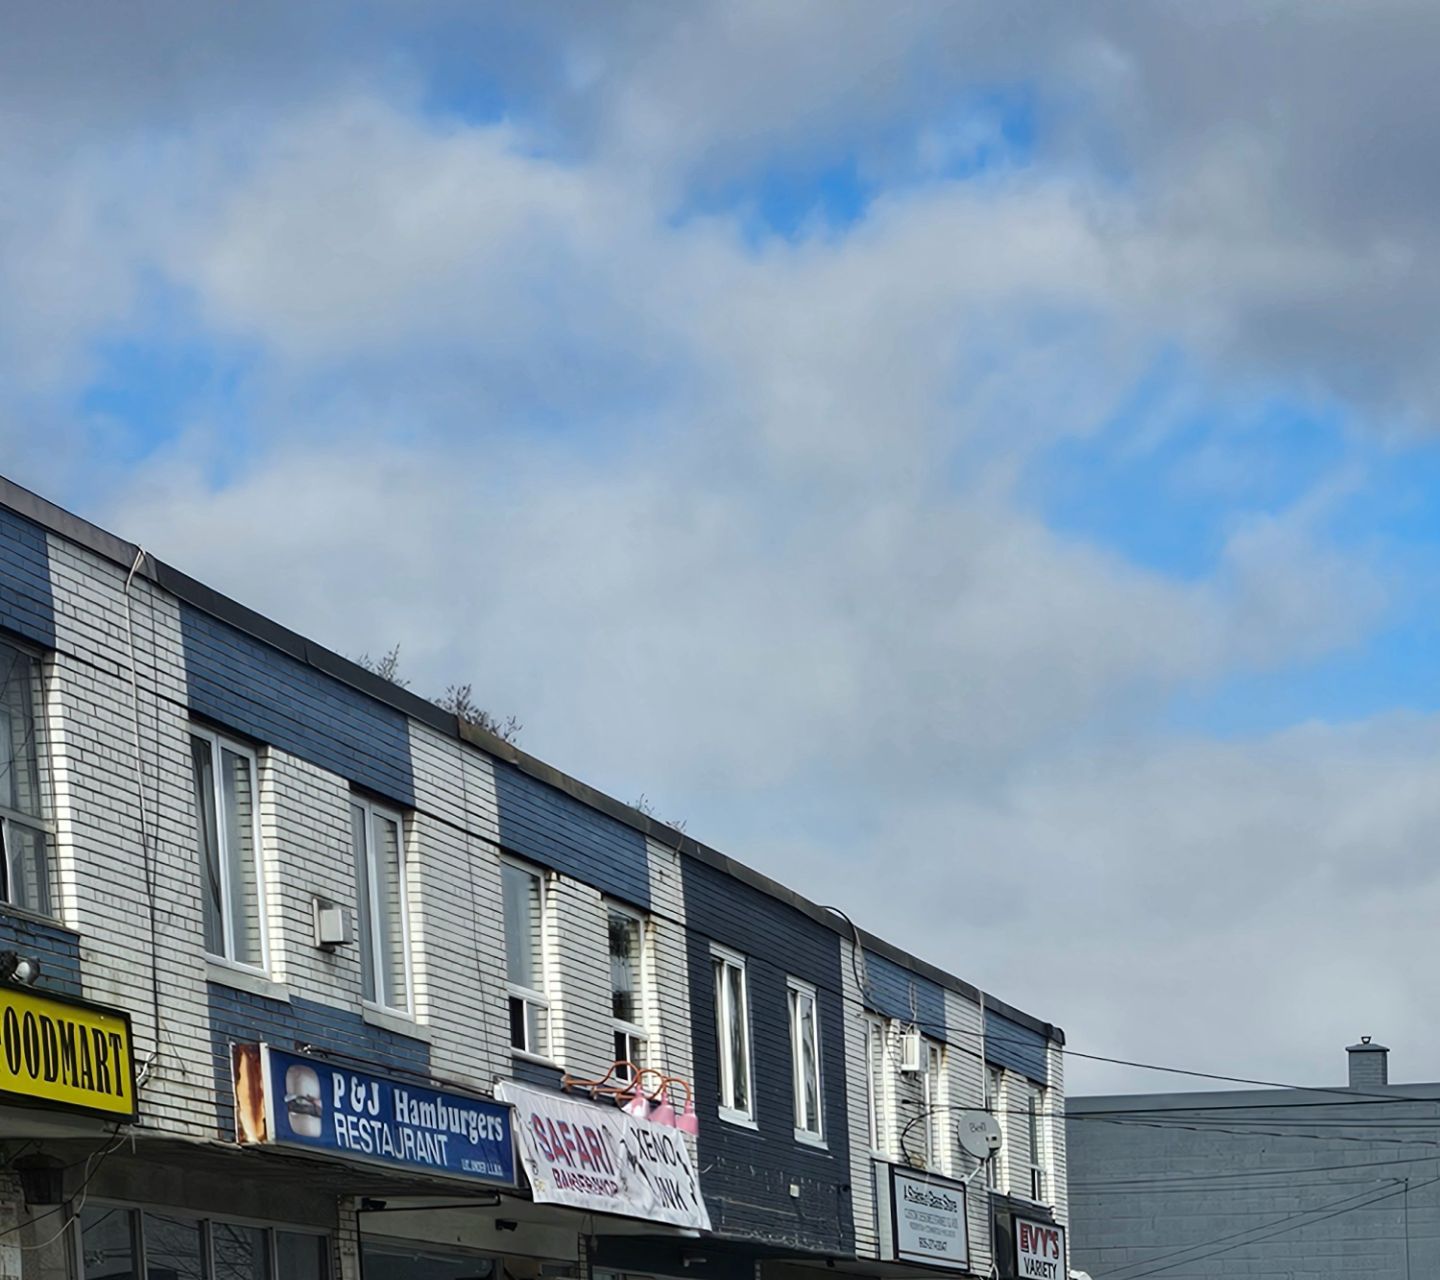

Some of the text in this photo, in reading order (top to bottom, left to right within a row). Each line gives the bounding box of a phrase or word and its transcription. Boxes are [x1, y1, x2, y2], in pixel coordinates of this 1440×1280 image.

[0, 1006, 123, 1097] OODMART
[333, 1112, 449, 1166] RESTAURANT
[393, 1088, 503, 1145] Hamburgers
[531, 1112, 615, 1176] SAFARI
[630, 1127, 678, 1167] XENO
[1024, 1257, 1058, 1280] VARIETY
